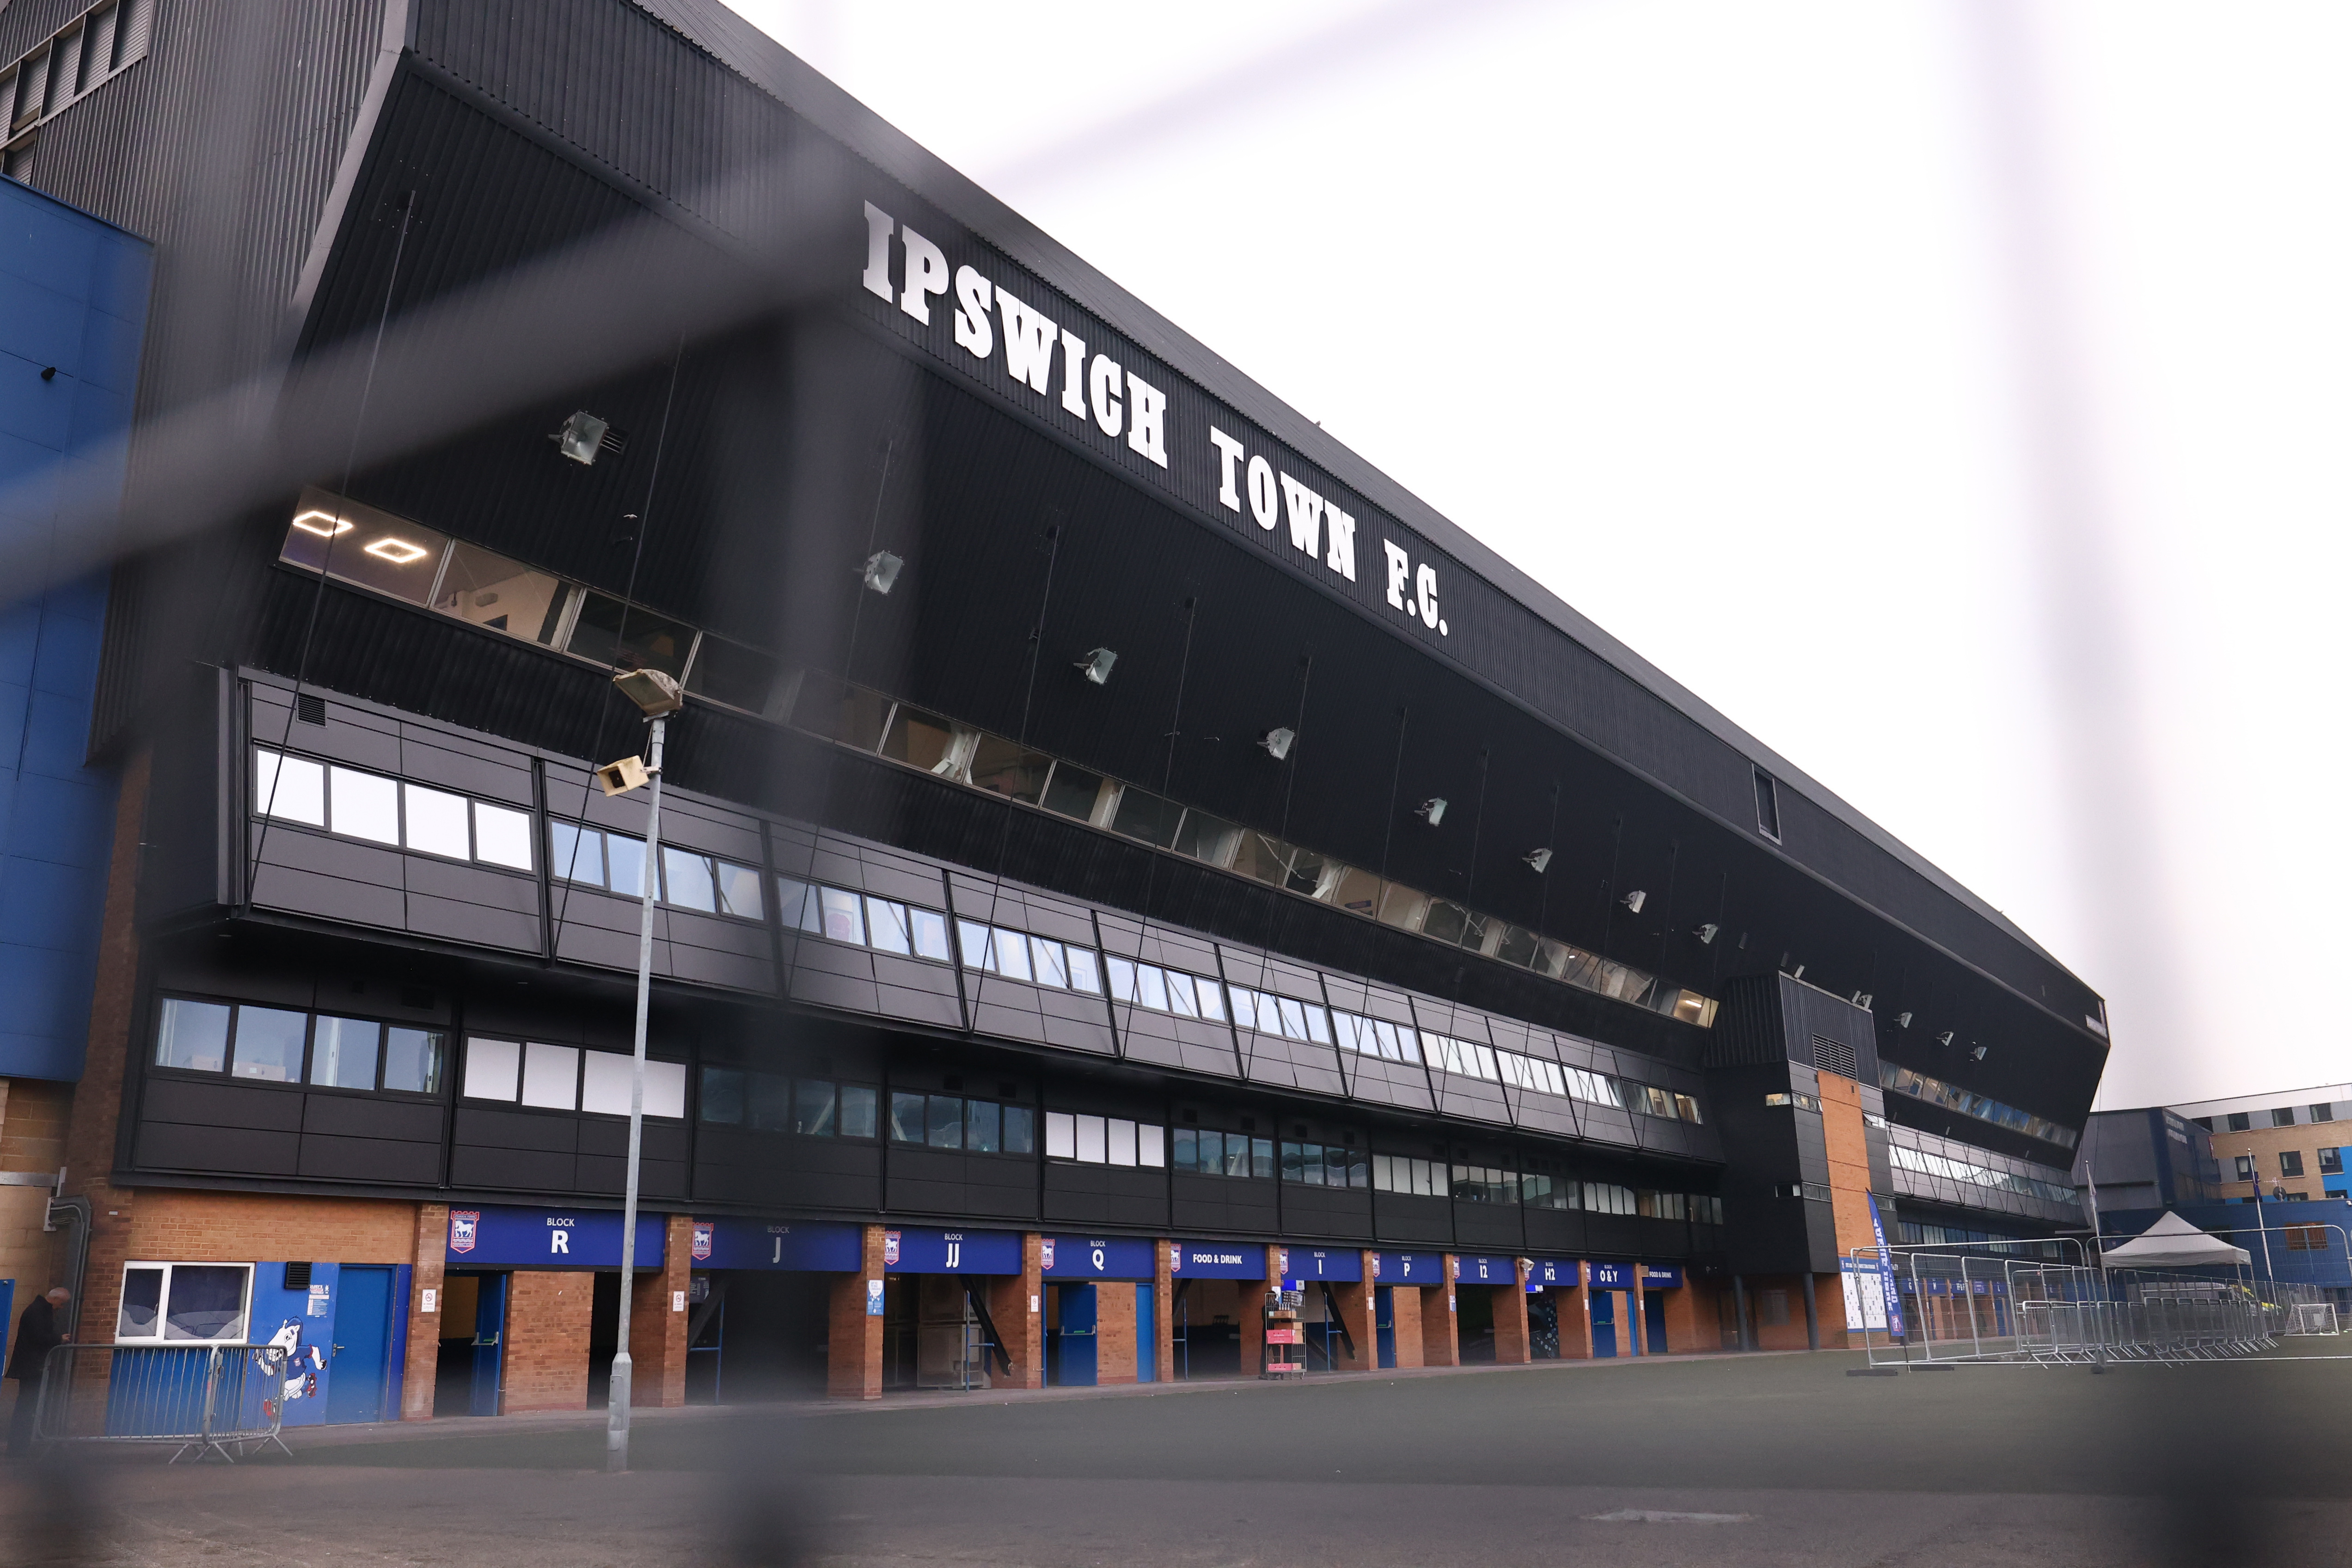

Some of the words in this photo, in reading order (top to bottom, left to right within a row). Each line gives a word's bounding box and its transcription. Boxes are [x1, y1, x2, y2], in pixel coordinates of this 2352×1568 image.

[863, 200, 1168, 469] IPSWICH
[1211, 425, 1355, 582] TOWN
[1384, 539, 1448, 636] F.C.
[547, 1218, 575, 1226] BLOCK
[551, 1230, 569, 1253] R
[772, 1237, 781, 1263] J
[946, 1243, 960, 1268] JJ
[1092, 1249, 1104, 1271] Q
[1193, 1254, 1212, 1263] FOOD
[1213, 1254, 1219, 1263] &
[1220, 1255, 1242, 1264] DRINK
[1404, 1262, 1410, 1277] P
[1545, 1268, 1556, 1280] H2
[1600, 1270, 1606, 1282] O
[1607, 1270, 1612, 1282] &
[1612, 1270, 1618, 1282] Y
